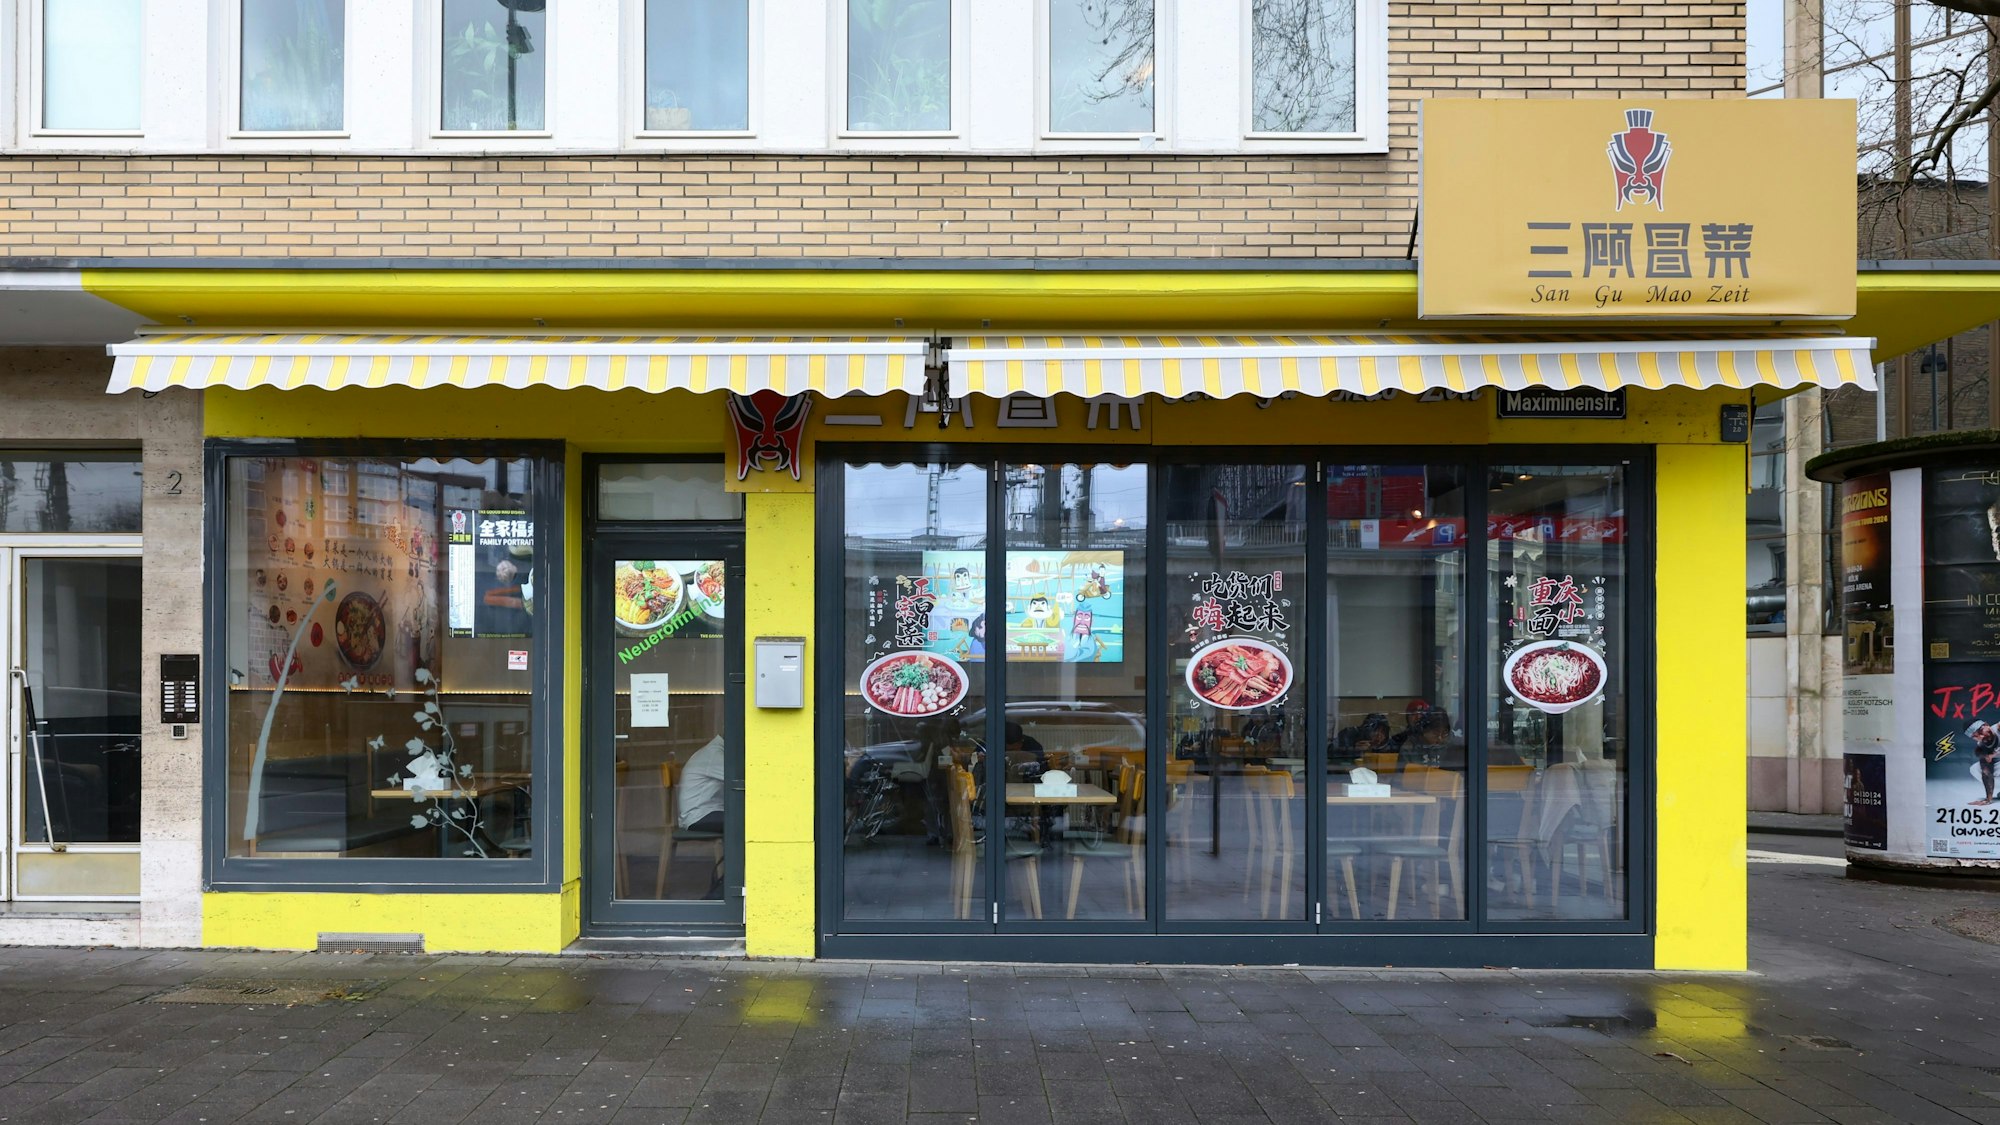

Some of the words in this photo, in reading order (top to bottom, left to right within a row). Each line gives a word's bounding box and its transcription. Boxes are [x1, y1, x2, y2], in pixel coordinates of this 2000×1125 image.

[1527, 222, 1753, 278] 三顾冒菜
[1531, 285, 1569, 303] San
[1595, 285, 1622, 308] Gu
[1646, 286, 1691, 303] Mao
[1707, 284, 1750, 302] Zeit
[1506, 393, 1620, 412] Maximinenstr.
[166, 470, 182, 495] 2
[480, 538, 501, 546] FAMILY
[1202, 571, 1274, 600] 吃货们
[1193, 597, 1291, 632] 嗨起来
[618, 592, 722, 665] Neueröffnung
[1936, 808, 2000, 825] 21.05.2
